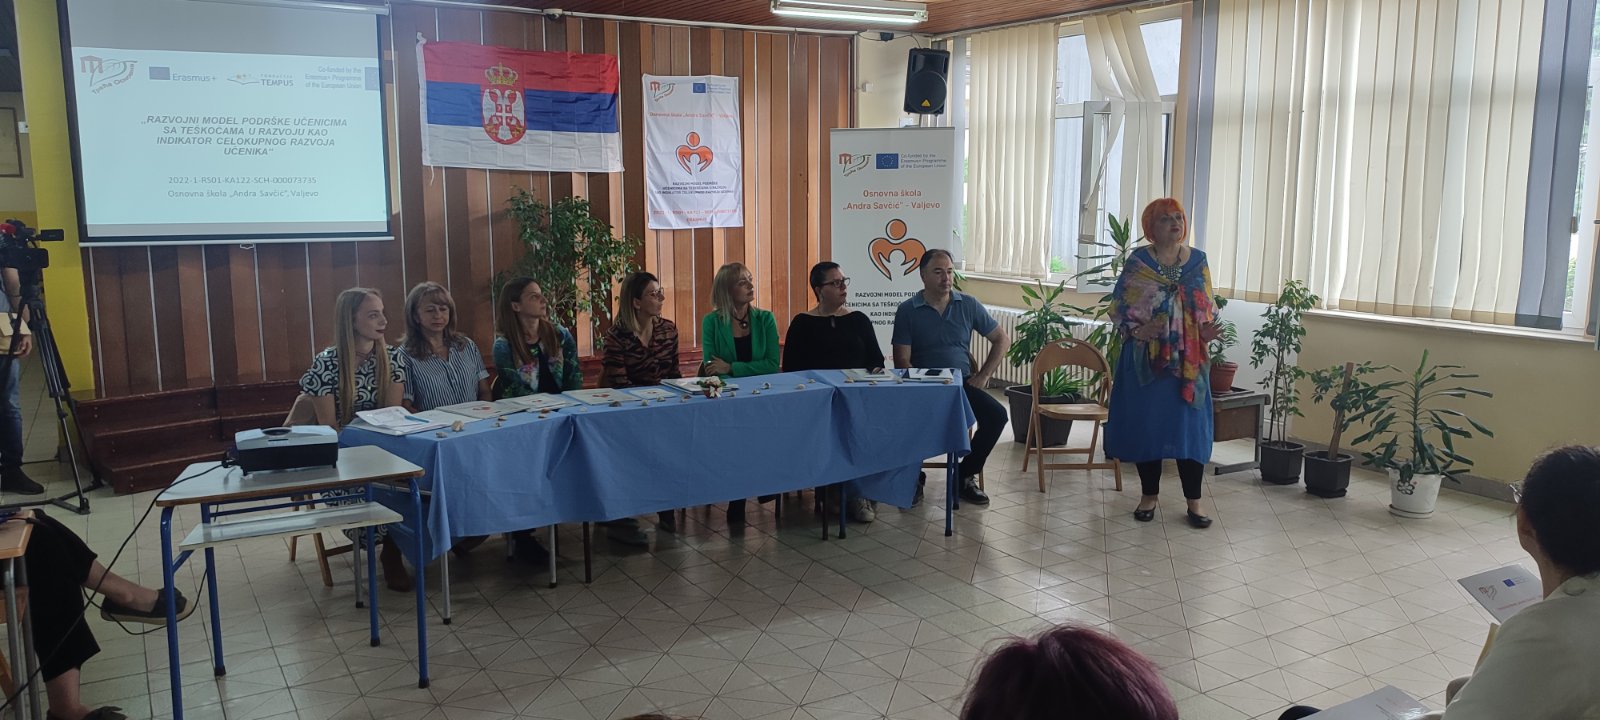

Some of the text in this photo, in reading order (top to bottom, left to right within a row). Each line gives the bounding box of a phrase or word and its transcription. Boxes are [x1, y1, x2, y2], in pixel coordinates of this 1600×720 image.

[172, 73, 216, 82] Erasmus+
[260, 79, 294, 87] TEMPUS
[202, 116, 239, 125] MODEL
[242, 115, 291, 126] PODRŠKE
[293, 116, 348, 127] UČENICIMA
[163, 126, 177, 135] SA
[249, 127, 255, 135] U
[258, 127, 305, 136] RAZVOJU
[307, 128, 328, 137] KAO
[156, 136, 335, 147] INDIKATOR CELOKUPNOG RAZVOJA
[168, 189, 204, 198] Osnovna
[206, 189, 227, 198] škola
[291, 189, 319, 200] Valjevo
[863, 189, 922, 198] Osnovna škola
[911, 201, 941, 211] Valjevo
